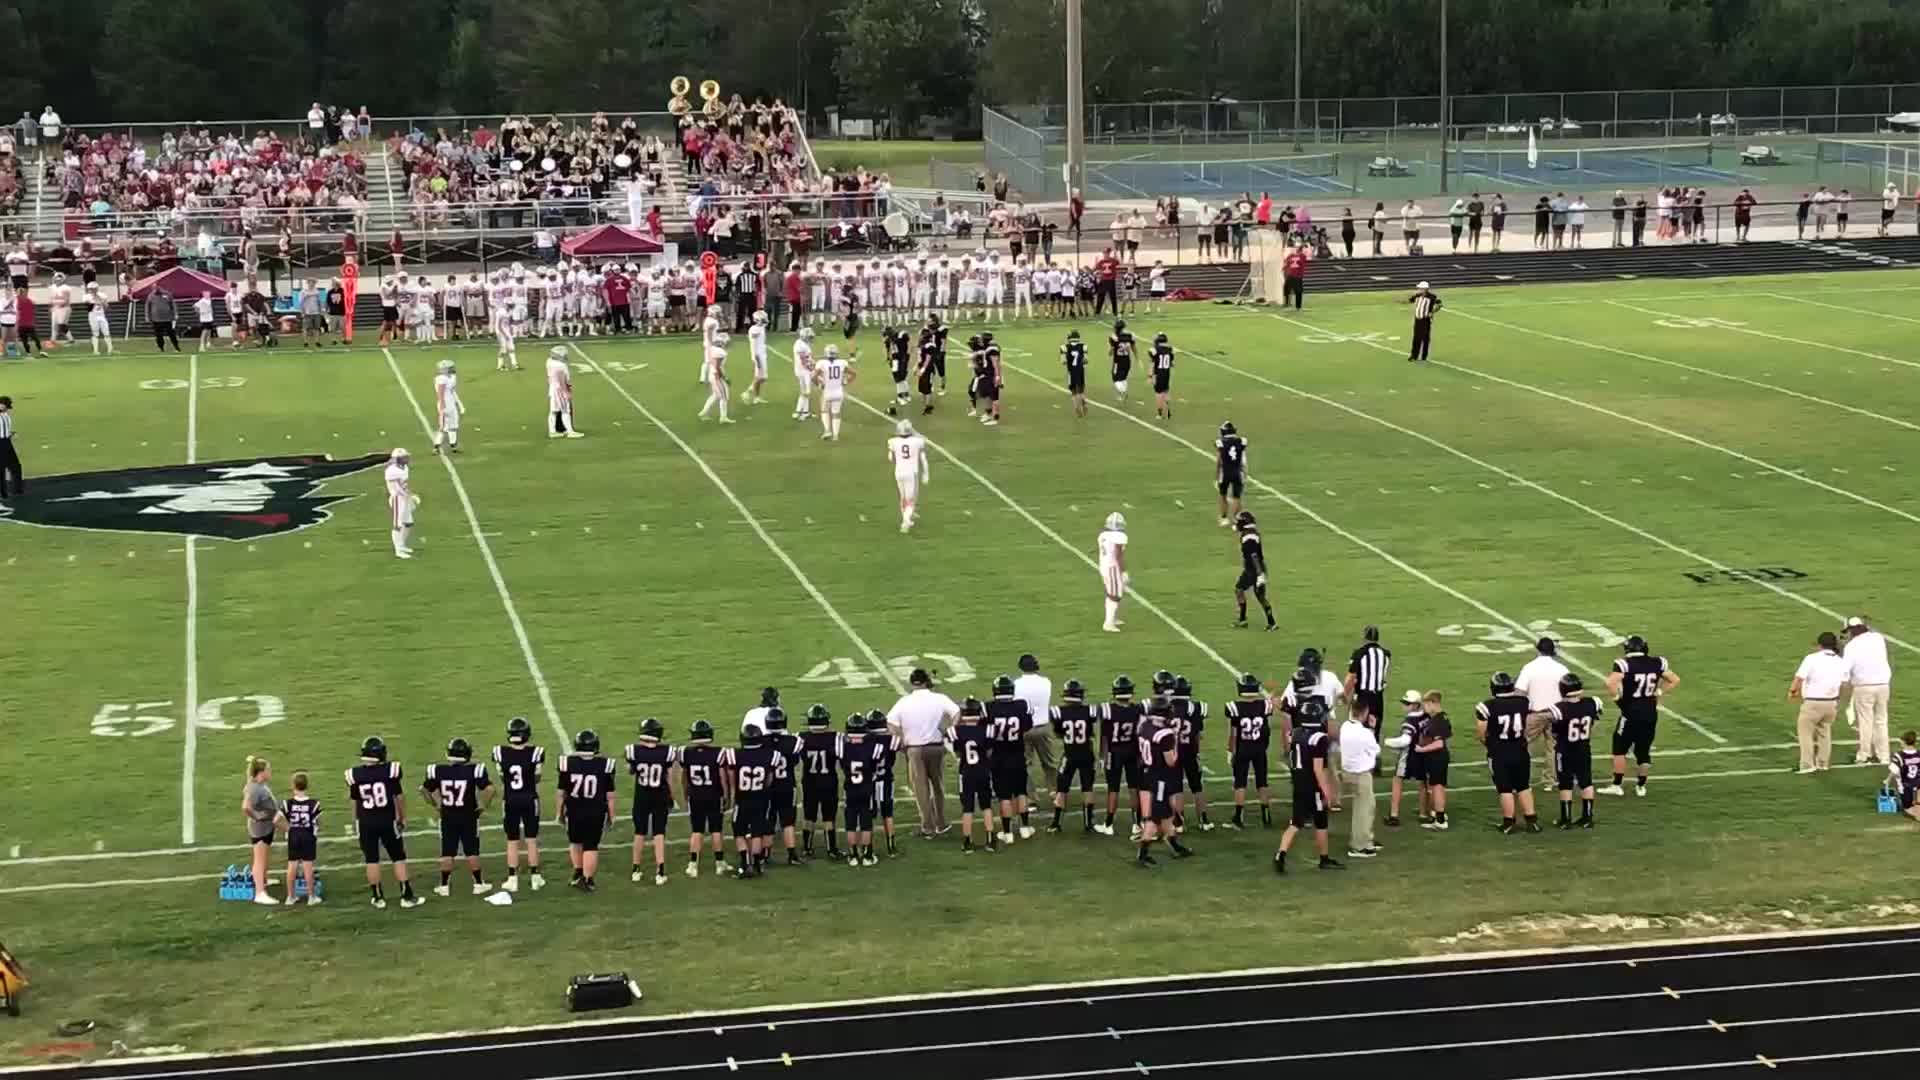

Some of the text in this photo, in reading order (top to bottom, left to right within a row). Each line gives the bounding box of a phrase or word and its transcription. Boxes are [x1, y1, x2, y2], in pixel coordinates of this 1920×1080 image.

[1070, 350, 1080, 366] 7
[1158, 353, 1170, 369] 10
[828, 365, 841, 380] 10
[901, 444, 911, 459] 9
[1436, 617, 1626, 653] 30
[797, 653, 976, 689] 40
[1632, 672, 1657, 698] 76
[90, 694, 289, 737] 50
[1497, 712, 1523, 740] 74
[994, 716, 1020, 743] 72
[1062, 719, 1087, 745] 33
[1567, 715, 1592, 742] 63
[807, 750, 829, 774] 71
[965, 740, 980, 765] 6
[509, 765, 523, 790] 3
[636, 763, 662, 787] 30
[690, 764, 713, 786] 51
[738, 765, 766, 791] 62
[850, 761, 864, 784] 5
[358, 781, 388, 809] 58
[441, 780, 467, 806] 57
[570, 774, 598, 799] 70
